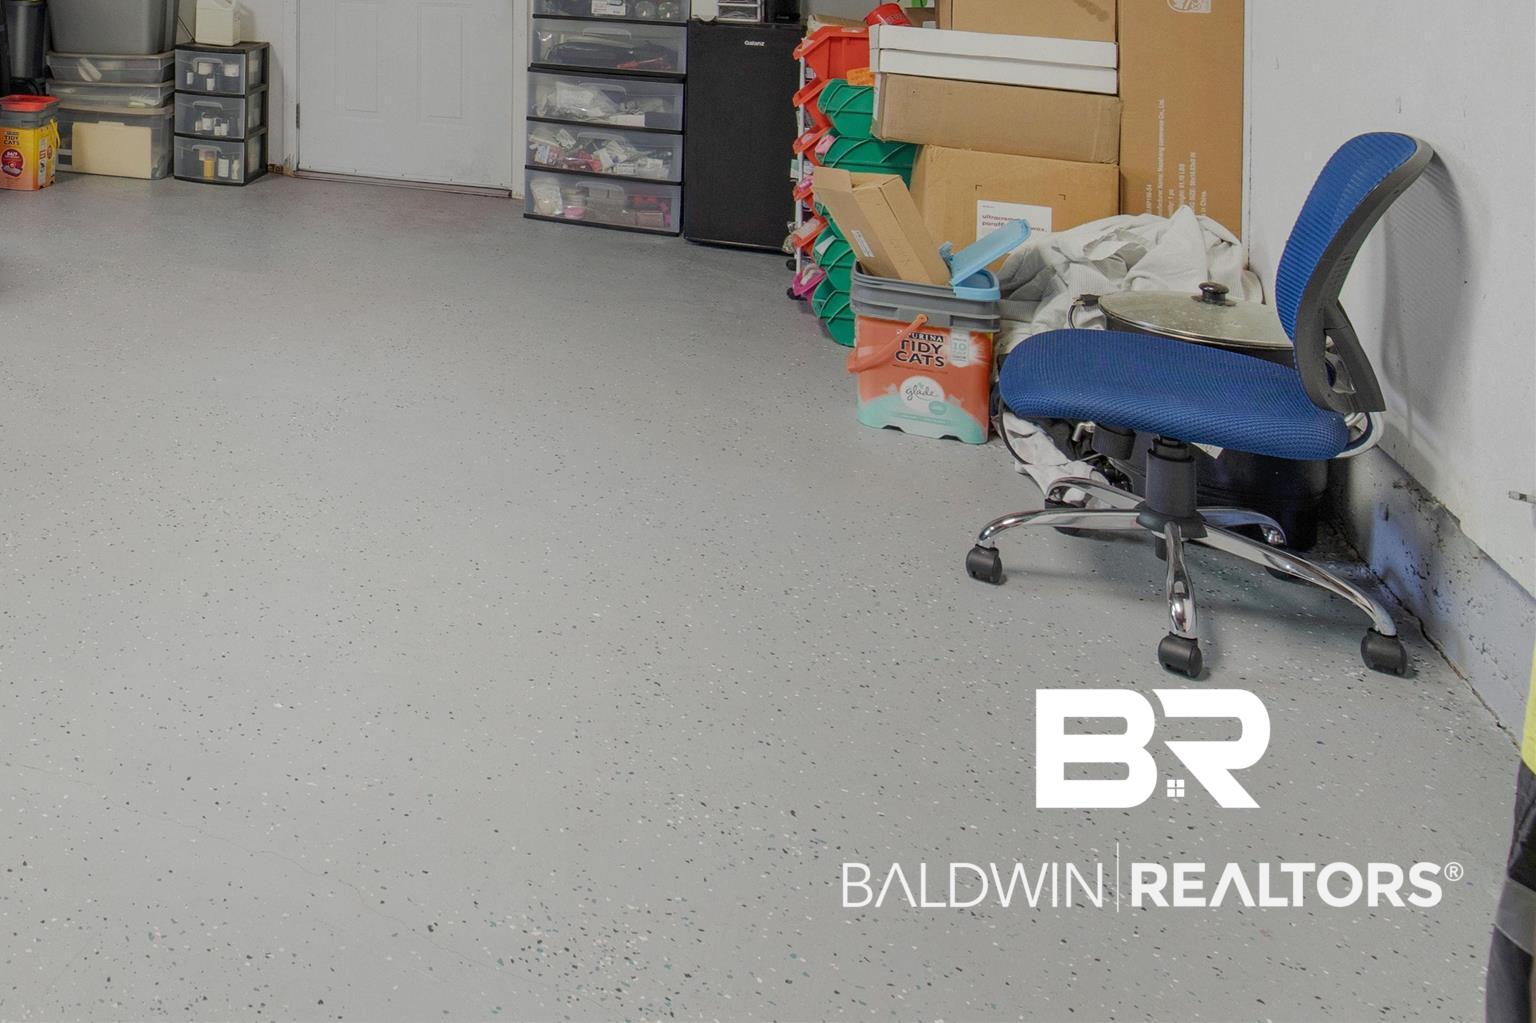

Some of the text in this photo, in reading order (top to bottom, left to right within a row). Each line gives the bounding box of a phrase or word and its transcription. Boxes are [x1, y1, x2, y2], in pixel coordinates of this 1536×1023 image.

[908, 332, 944, 342] URINA
[895, 350, 945, 367] CATS
[905, 384, 935, 401] glade
